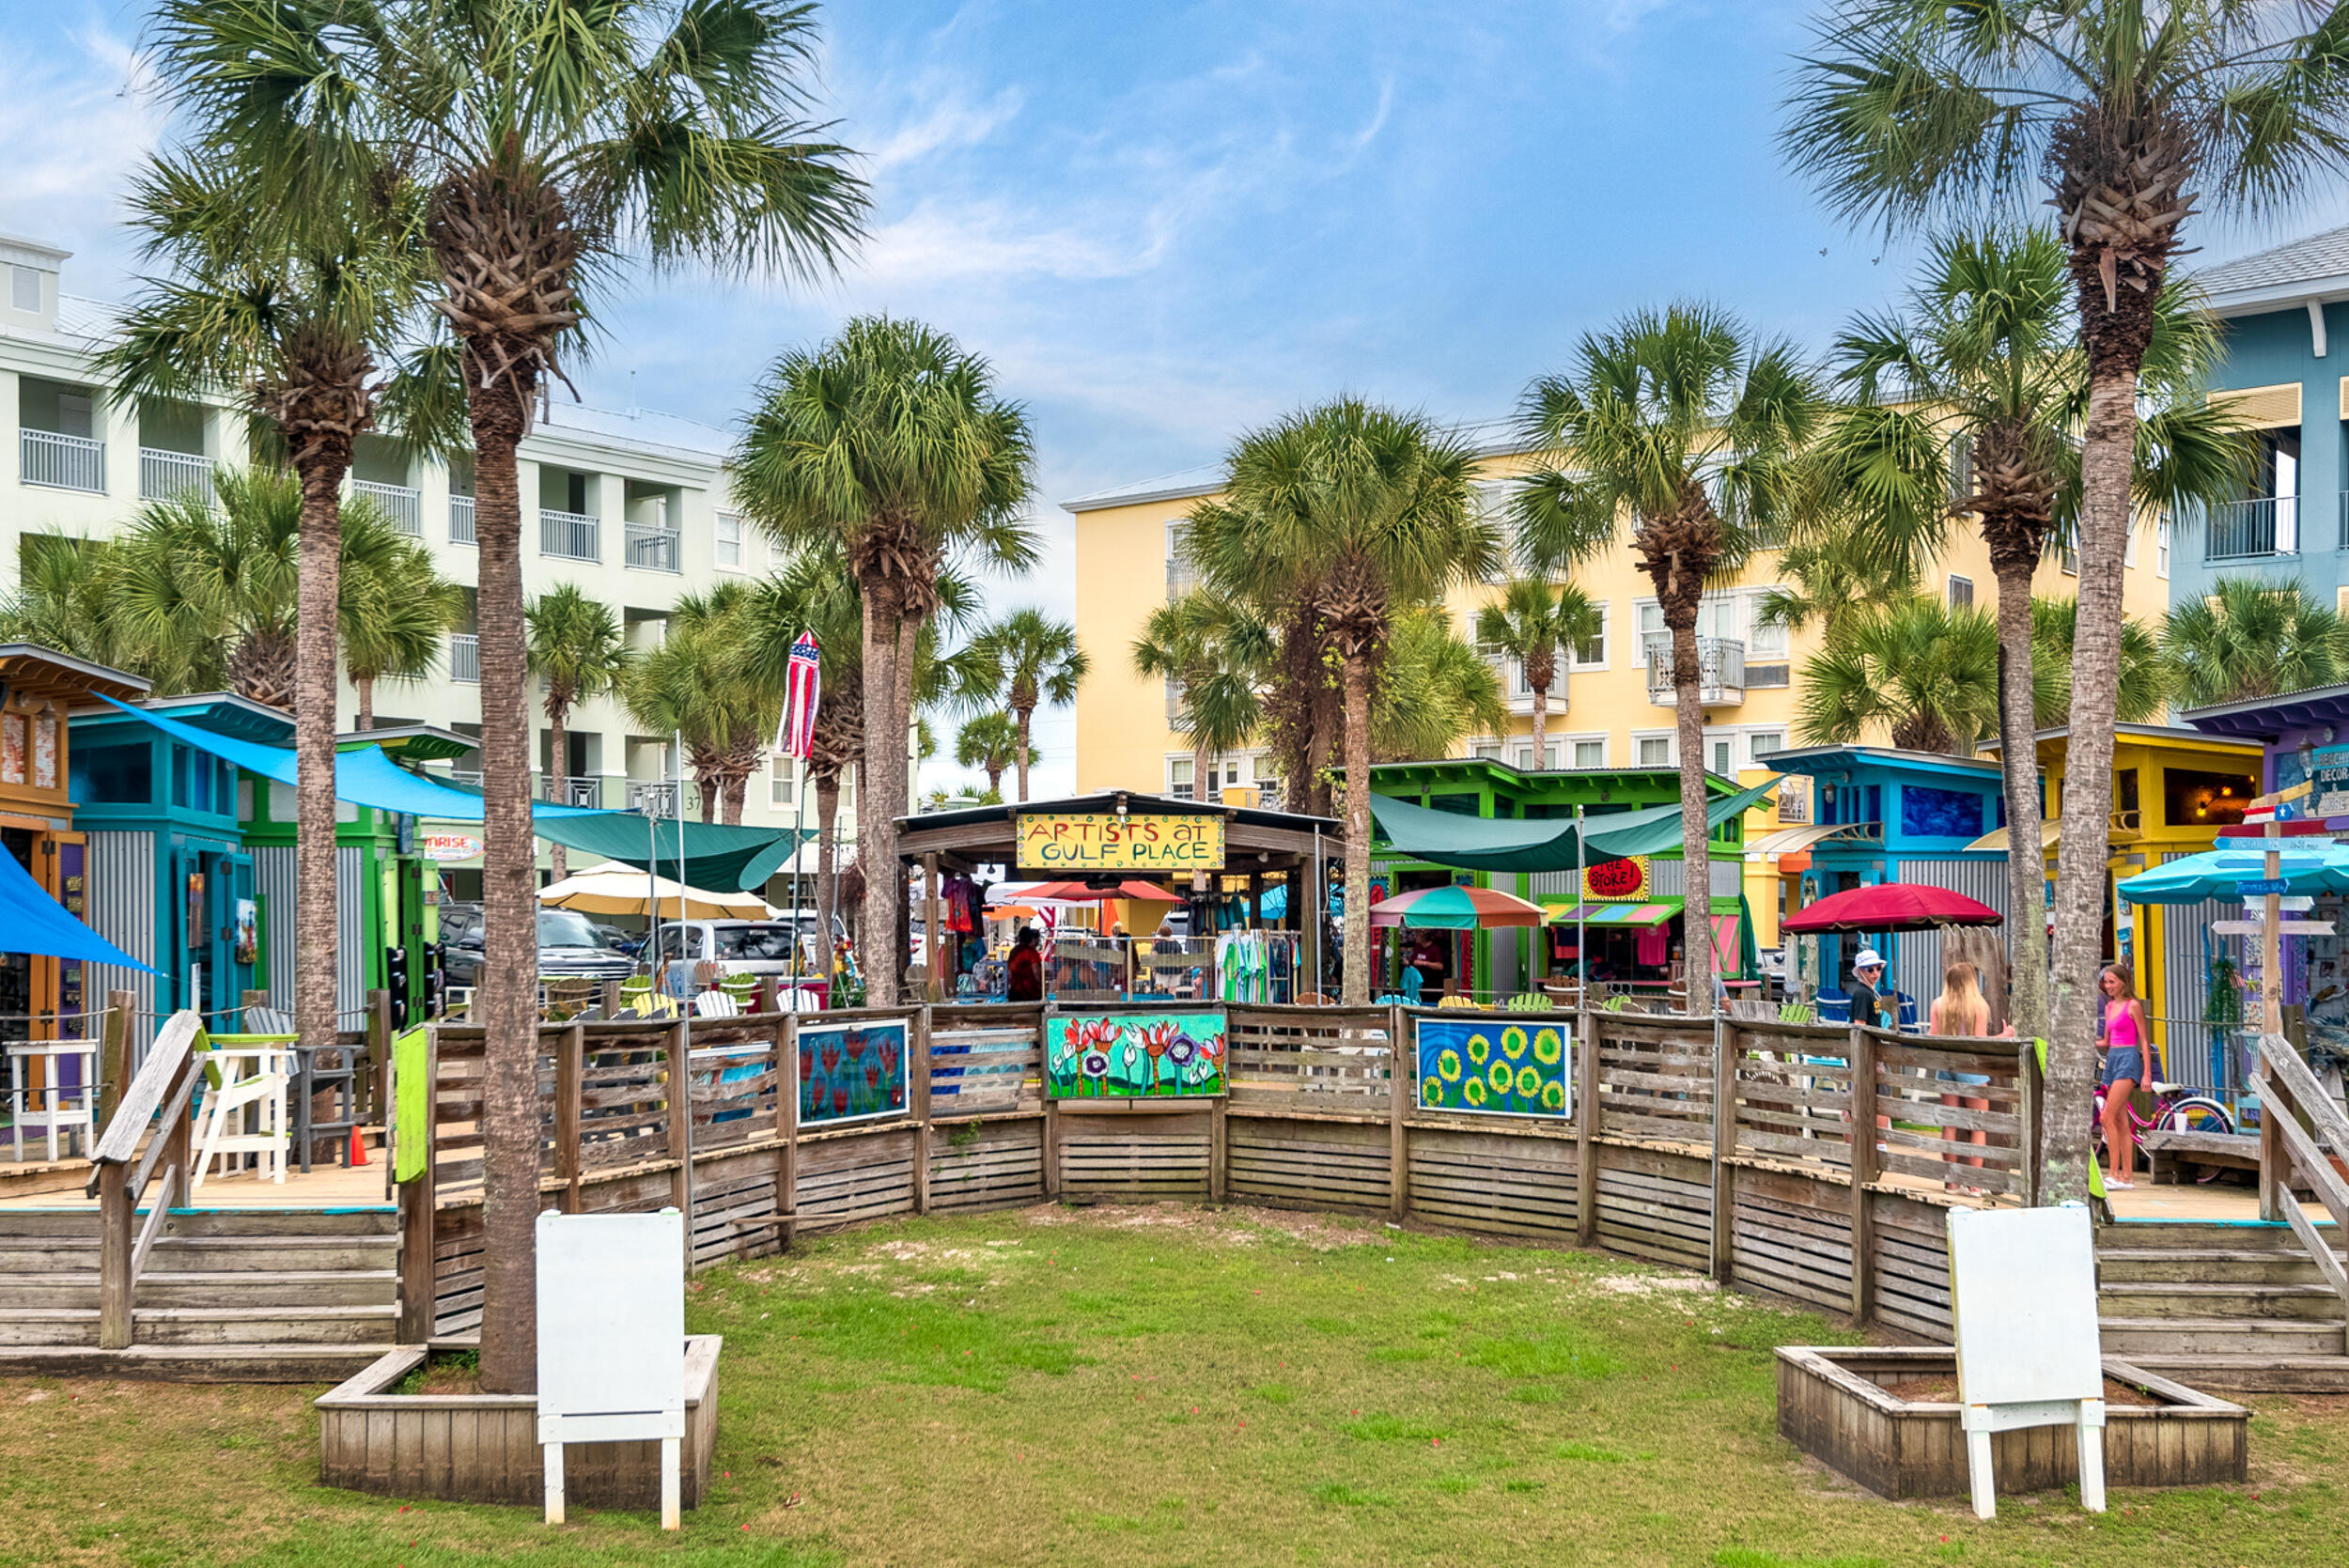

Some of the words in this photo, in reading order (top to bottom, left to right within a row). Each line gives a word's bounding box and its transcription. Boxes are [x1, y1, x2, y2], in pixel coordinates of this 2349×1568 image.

[686, 796, 701, 811] 37
[1027, 822, 1159, 843] ARTISTS
[1040, 843, 1120, 861] GULF
[1132, 841, 1210, 861] PLACE
